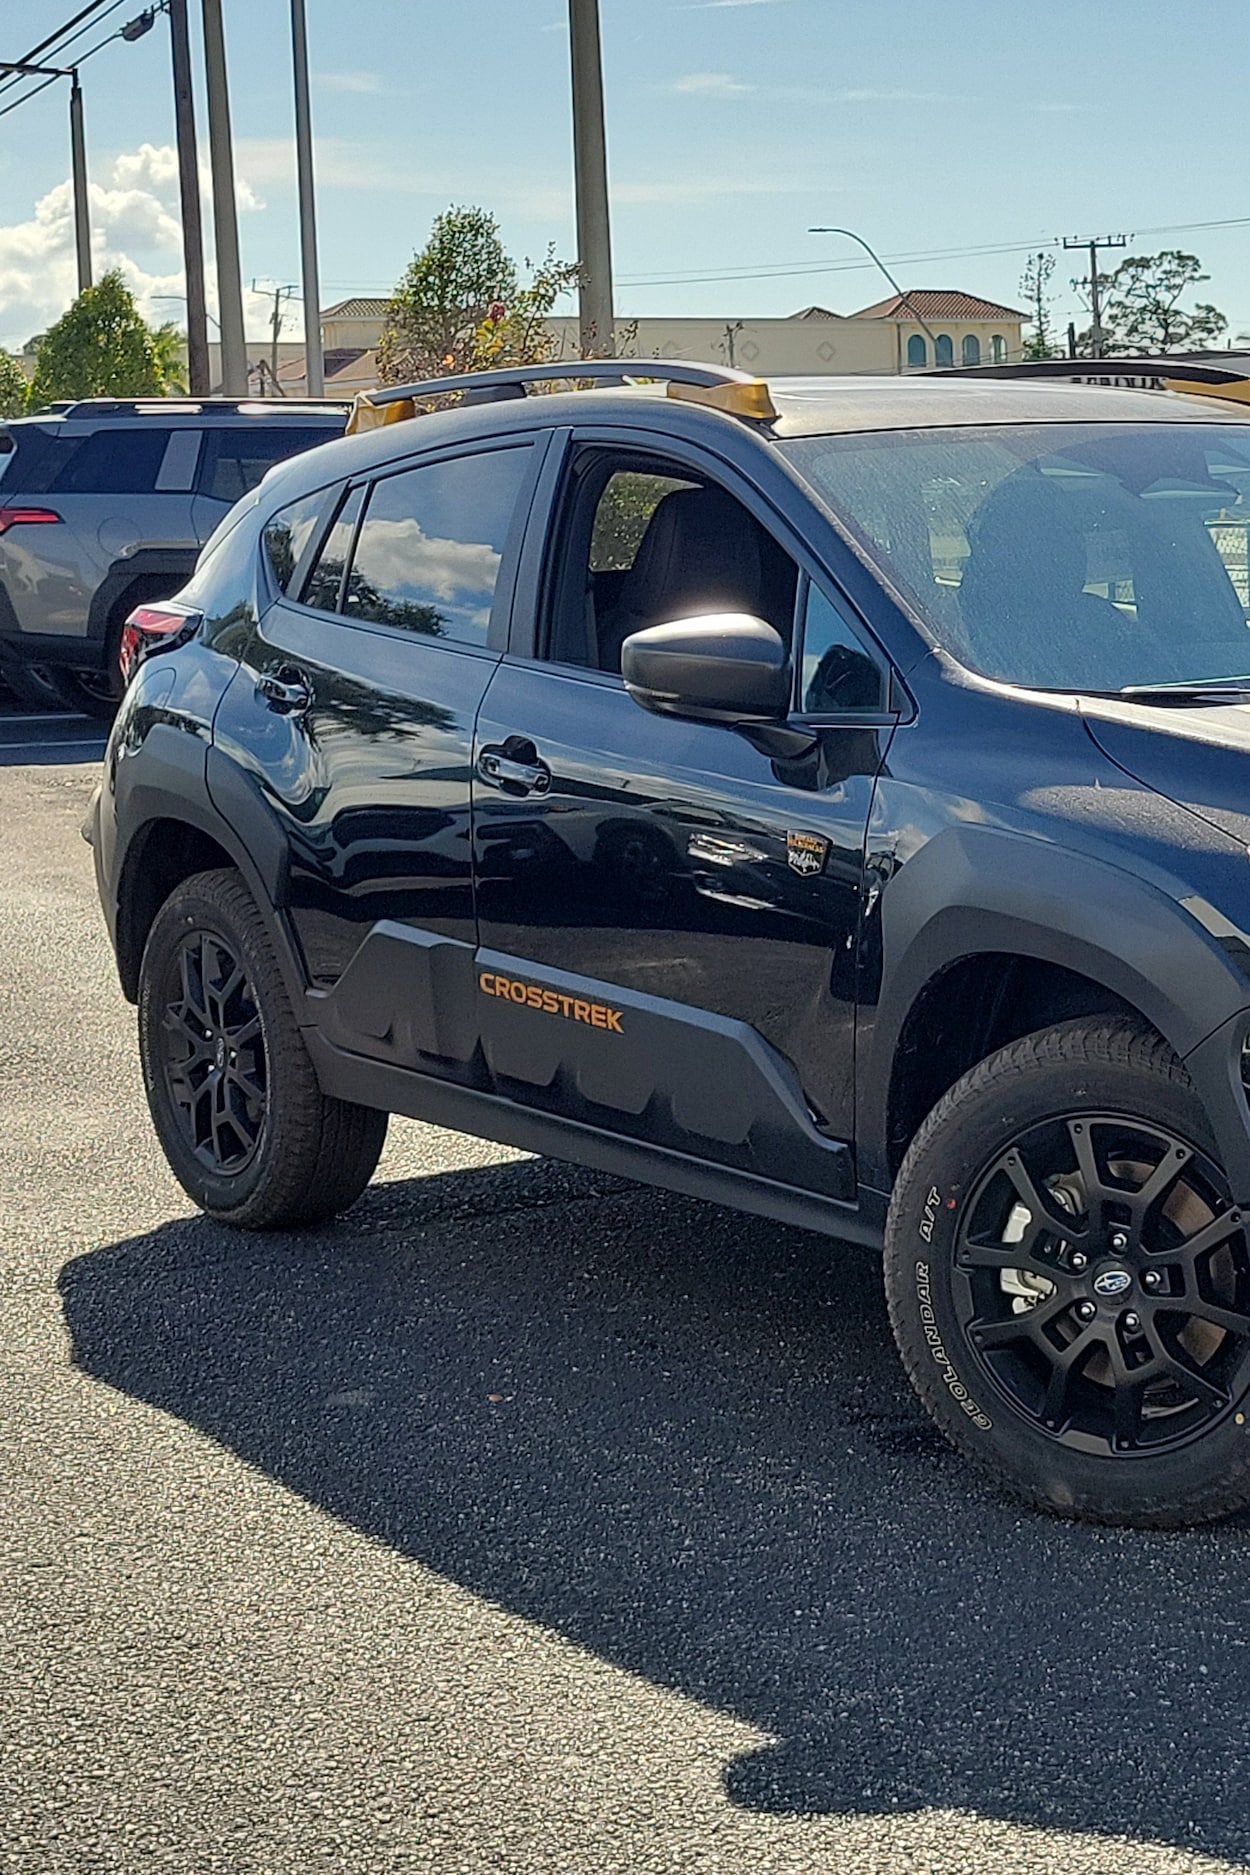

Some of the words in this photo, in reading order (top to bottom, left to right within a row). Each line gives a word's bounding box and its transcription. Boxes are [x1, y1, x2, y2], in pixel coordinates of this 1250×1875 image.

[479, 972, 625, 1034] CROSSTREK
[919, 1186, 941, 1243] A/T
[915, 1261, 993, 1431] GEOLANDAR
